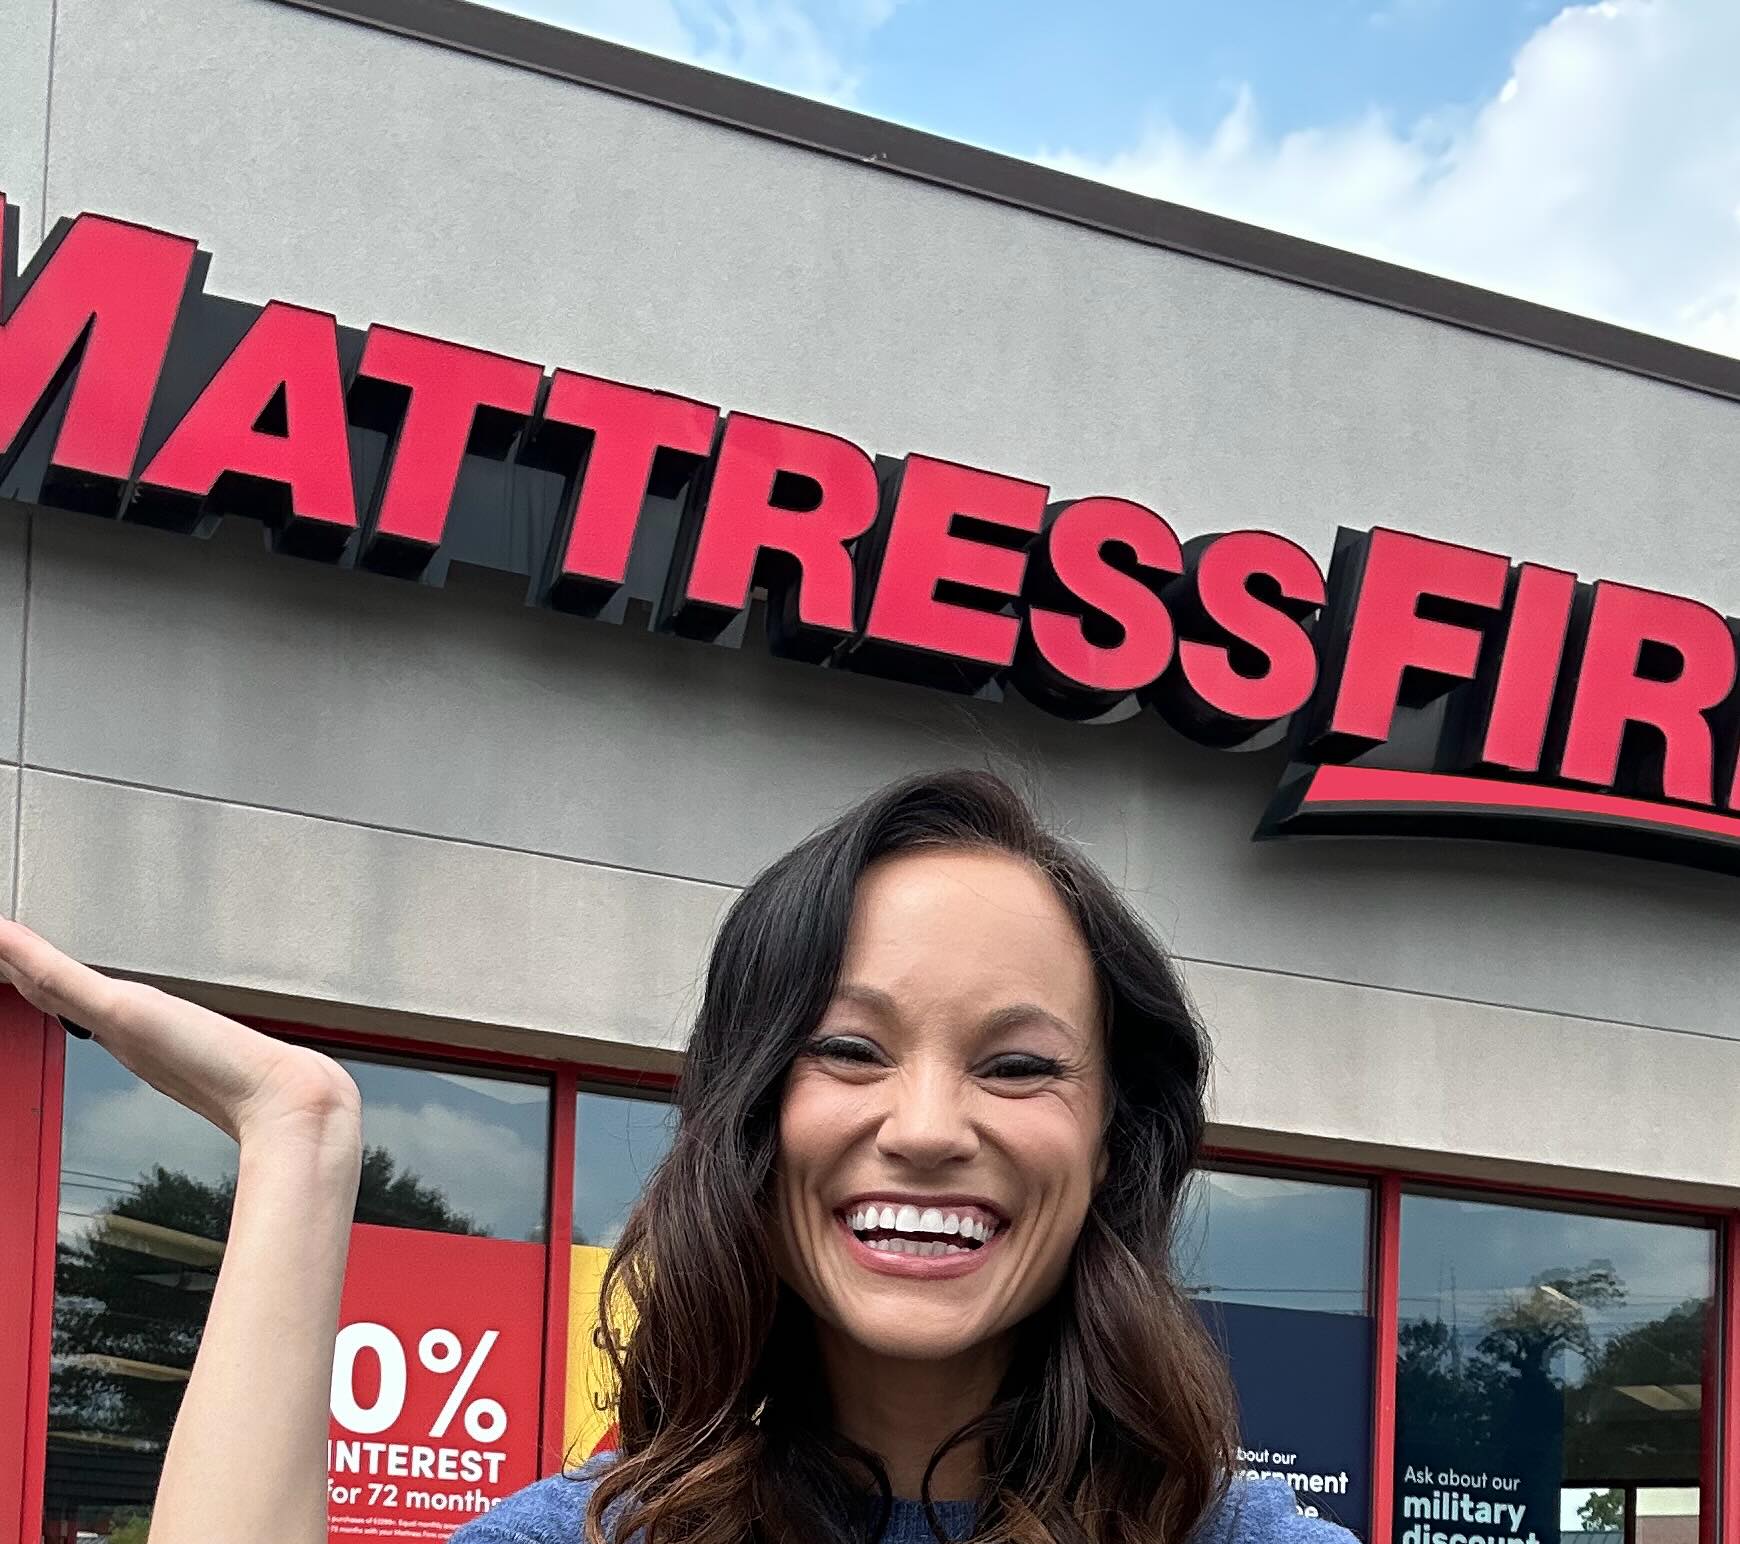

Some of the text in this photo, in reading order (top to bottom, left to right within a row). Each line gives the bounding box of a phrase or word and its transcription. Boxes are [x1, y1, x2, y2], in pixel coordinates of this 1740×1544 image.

[1330, 526, 1740, 808] FIR
[329, 1322, 507, 1443] 0%
[1236, 1446, 1297, 1465] bout our
[367, 1483, 398, 1507] 72
[1404, 1465, 1521, 1491] Ask about our
[1404, 1490, 1527, 1533] military
